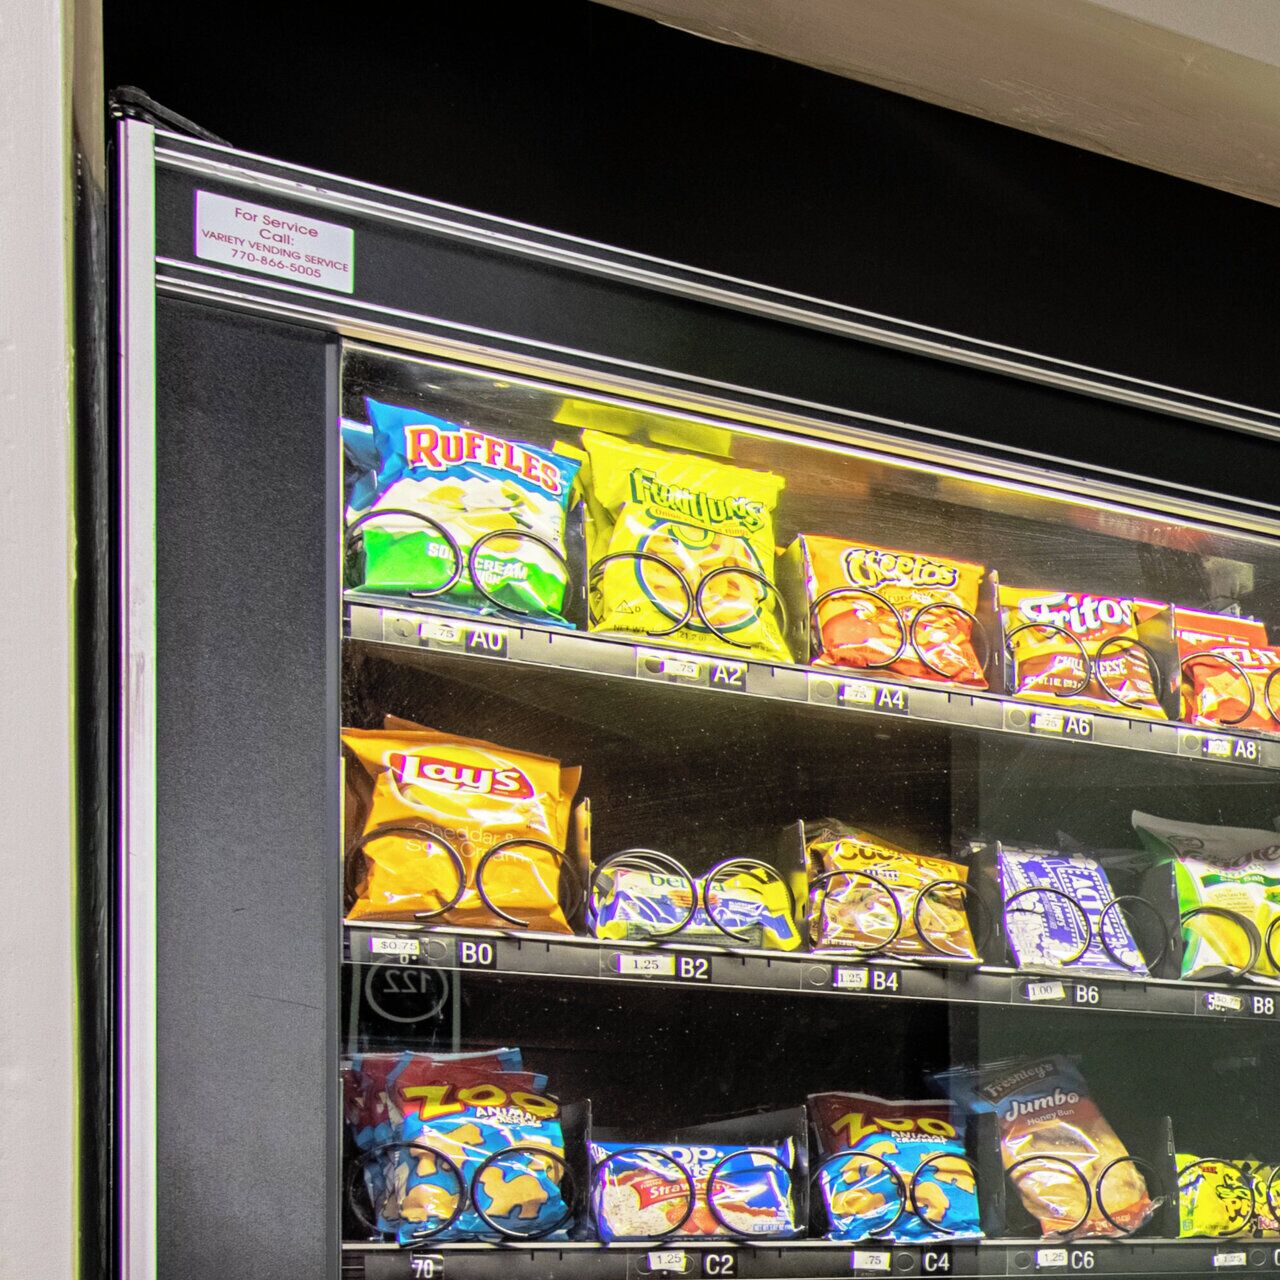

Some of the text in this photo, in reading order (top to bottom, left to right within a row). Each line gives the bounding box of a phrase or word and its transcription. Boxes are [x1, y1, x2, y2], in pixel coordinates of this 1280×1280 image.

[234, 207, 319, 238] For Service
[259, 228, 295, 246] Call:
[201, 229, 350, 273] VARIETY VENDING SERVICE
[231, 248, 322, 279] 770-866-5005
[406, 425, 563, 494] RUFFLES
[471, 630, 504, 651] A0
[713, 666, 743, 686] A2
[879, 690, 905, 710] A4
[1066, 715, 1091, 736] A6
[1235, 740, 1257, 760] A8
[400, 755, 521, 795] Lay's
[461, 942, 493, 965] B0
[633, 959, 659, 970] 1.25
[681, 957, 708, 980] B2
[839, 973, 863, 984] 1.25
[873, 970, 898, 992] B4
[1031, 985, 1053, 997] 1.00
[1076, 985, 1099, 1004] B6
[1253, 996, 1274, 1015] B8
[403, 1083, 559, 1121] ZOO
[1005, 1088, 1080, 1122] Jumbo
[1026, 1107, 1075, 1127] Honey Bun
[831, 1112, 957, 1147] ZOO
[658, 1254, 682, 1264] 1.25
[705, 1254, 734, 1275] C2
[924, 1252, 950, 1271] C4
[1071, 1250, 1095, 1269] C6
